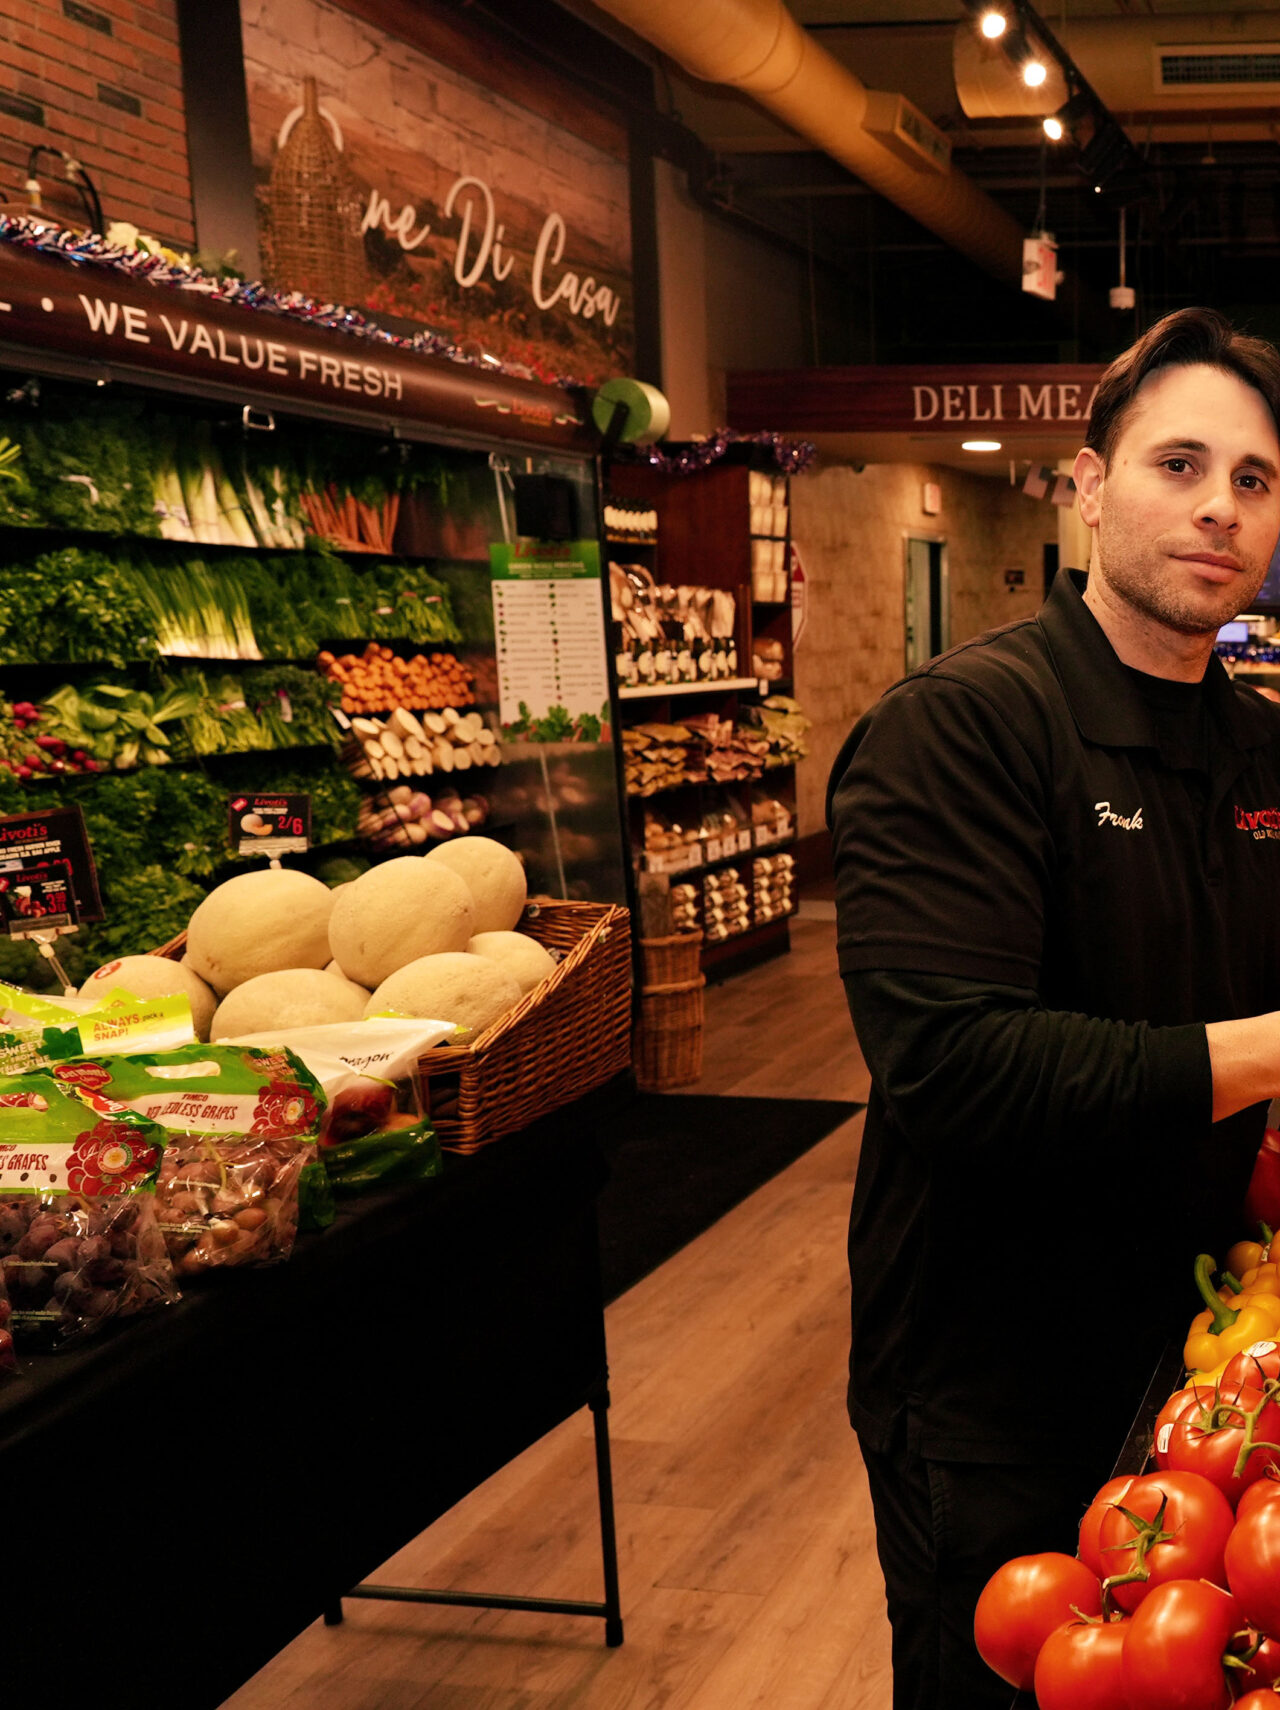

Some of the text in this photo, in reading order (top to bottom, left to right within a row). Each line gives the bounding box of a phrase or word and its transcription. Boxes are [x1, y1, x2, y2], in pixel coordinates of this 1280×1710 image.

[445, 176, 515, 288] Di
[532, 213, 620, 326] Casa
[79, 294, 403, 400] WE VALUE FRESH
[913, 385, 1004, 422] DELI
[278, 815, 304, 836] 2/6
[93, 1013, 140, 1034] ALWAYS
[94, 1027, 129, 1042] SNAP!
[201, 1105, 239, 1120] GRAPES
[7, 1154, 49, 1171] GRAPES
